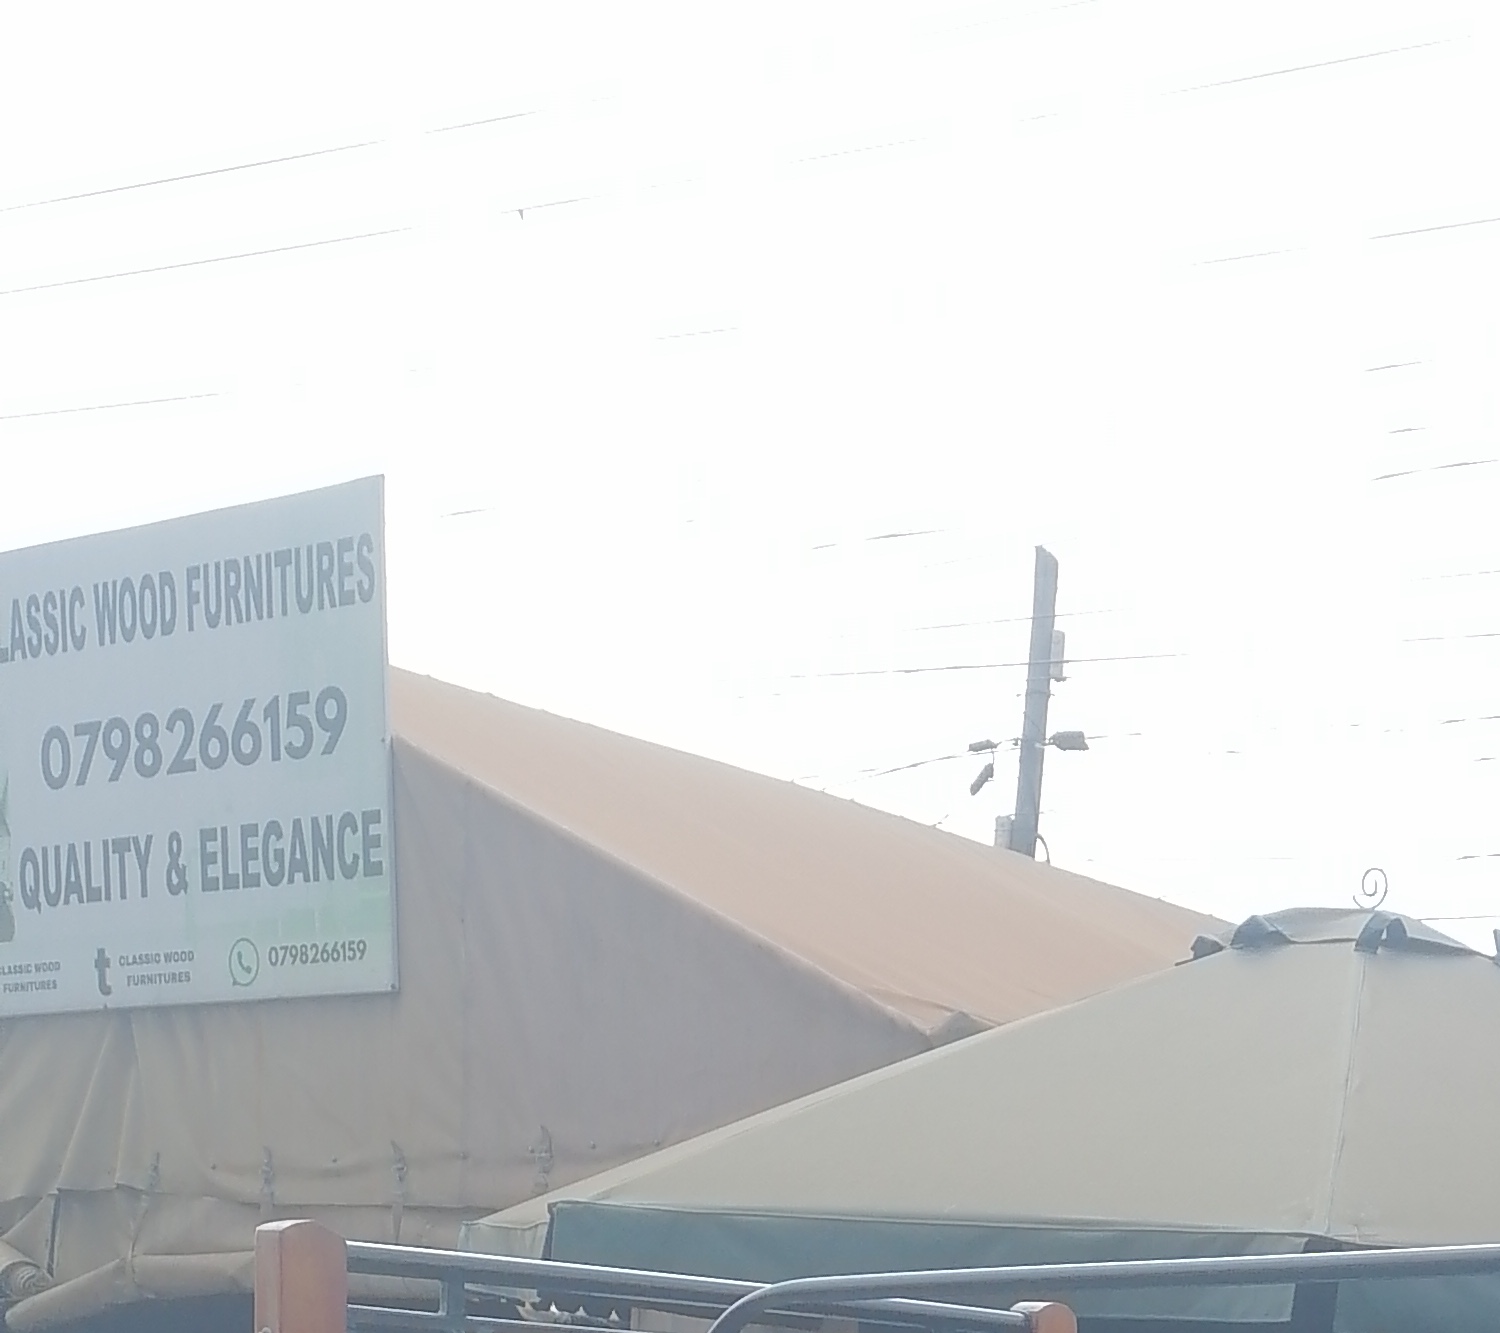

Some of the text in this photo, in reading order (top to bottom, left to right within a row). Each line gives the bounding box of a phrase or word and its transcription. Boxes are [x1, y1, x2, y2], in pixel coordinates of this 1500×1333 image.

[0, 533, 375, 663] ASSIC WOOD FURNITURES
[41, 686, 348, 790] 0798266159
[20, 809, 384, 914] QUALITY & ELEGANCE
[118, 950, 195, 967] CLASSIC WOOD
[268, 940, 367, 967] 0798266159
[34, 961, 61, 973] WOOD
[3, 979, 58, 993] FURNITURES
[127, 971, 191, 986] FURNITURES
